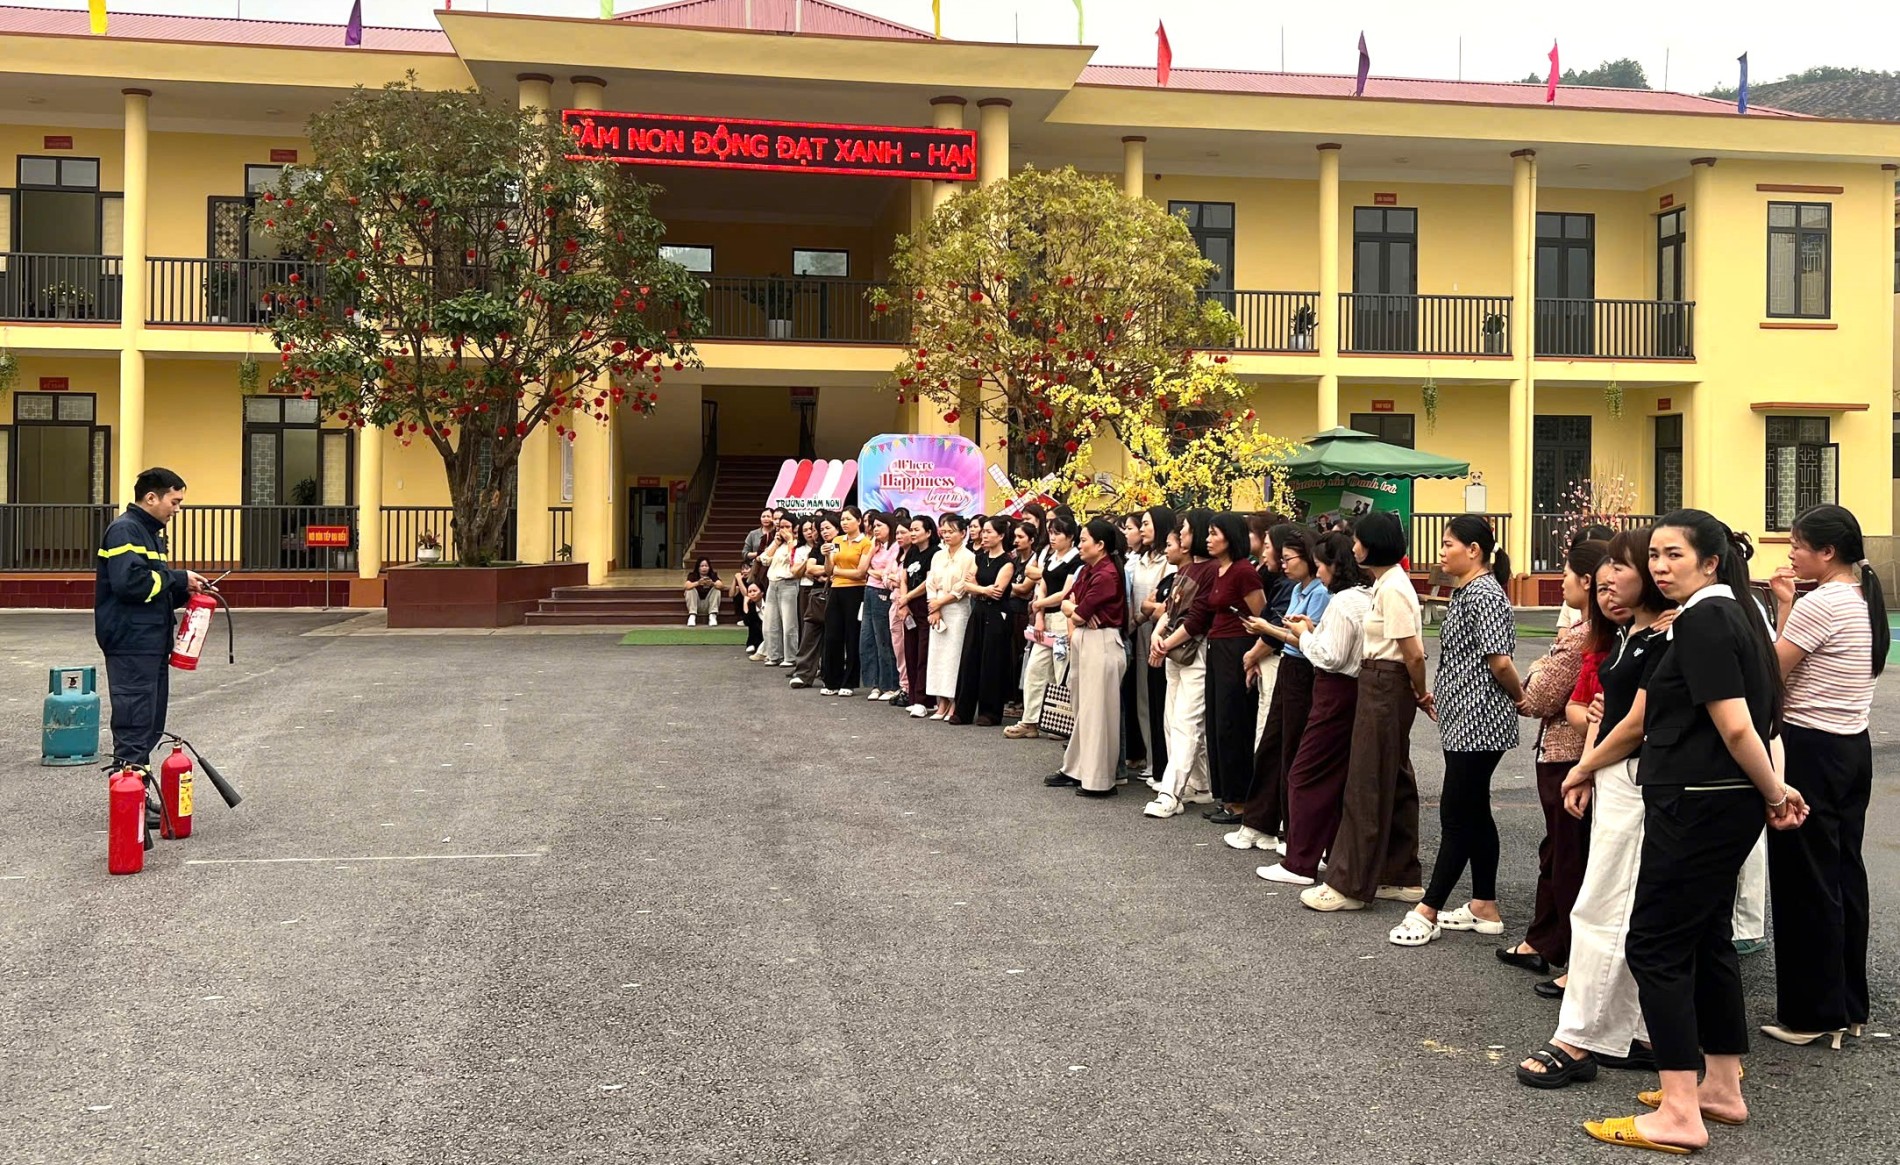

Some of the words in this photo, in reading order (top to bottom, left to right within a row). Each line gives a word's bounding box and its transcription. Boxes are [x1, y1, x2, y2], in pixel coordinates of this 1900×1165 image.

[627, 127, 685, 154] NON
[692, 124, 769, 161] ĐỘNG
[775, 135, 829, 166] ĐẠT
[833, 138, 903, 165] XANH
[890, 459, 935, 472] Where
[881, 472, 955, 491] Happiness
[775, 496, 805, 508] TRƯỜNG
[825, 499, 840, 508] NON
[926, 487, 969, 508] begins
